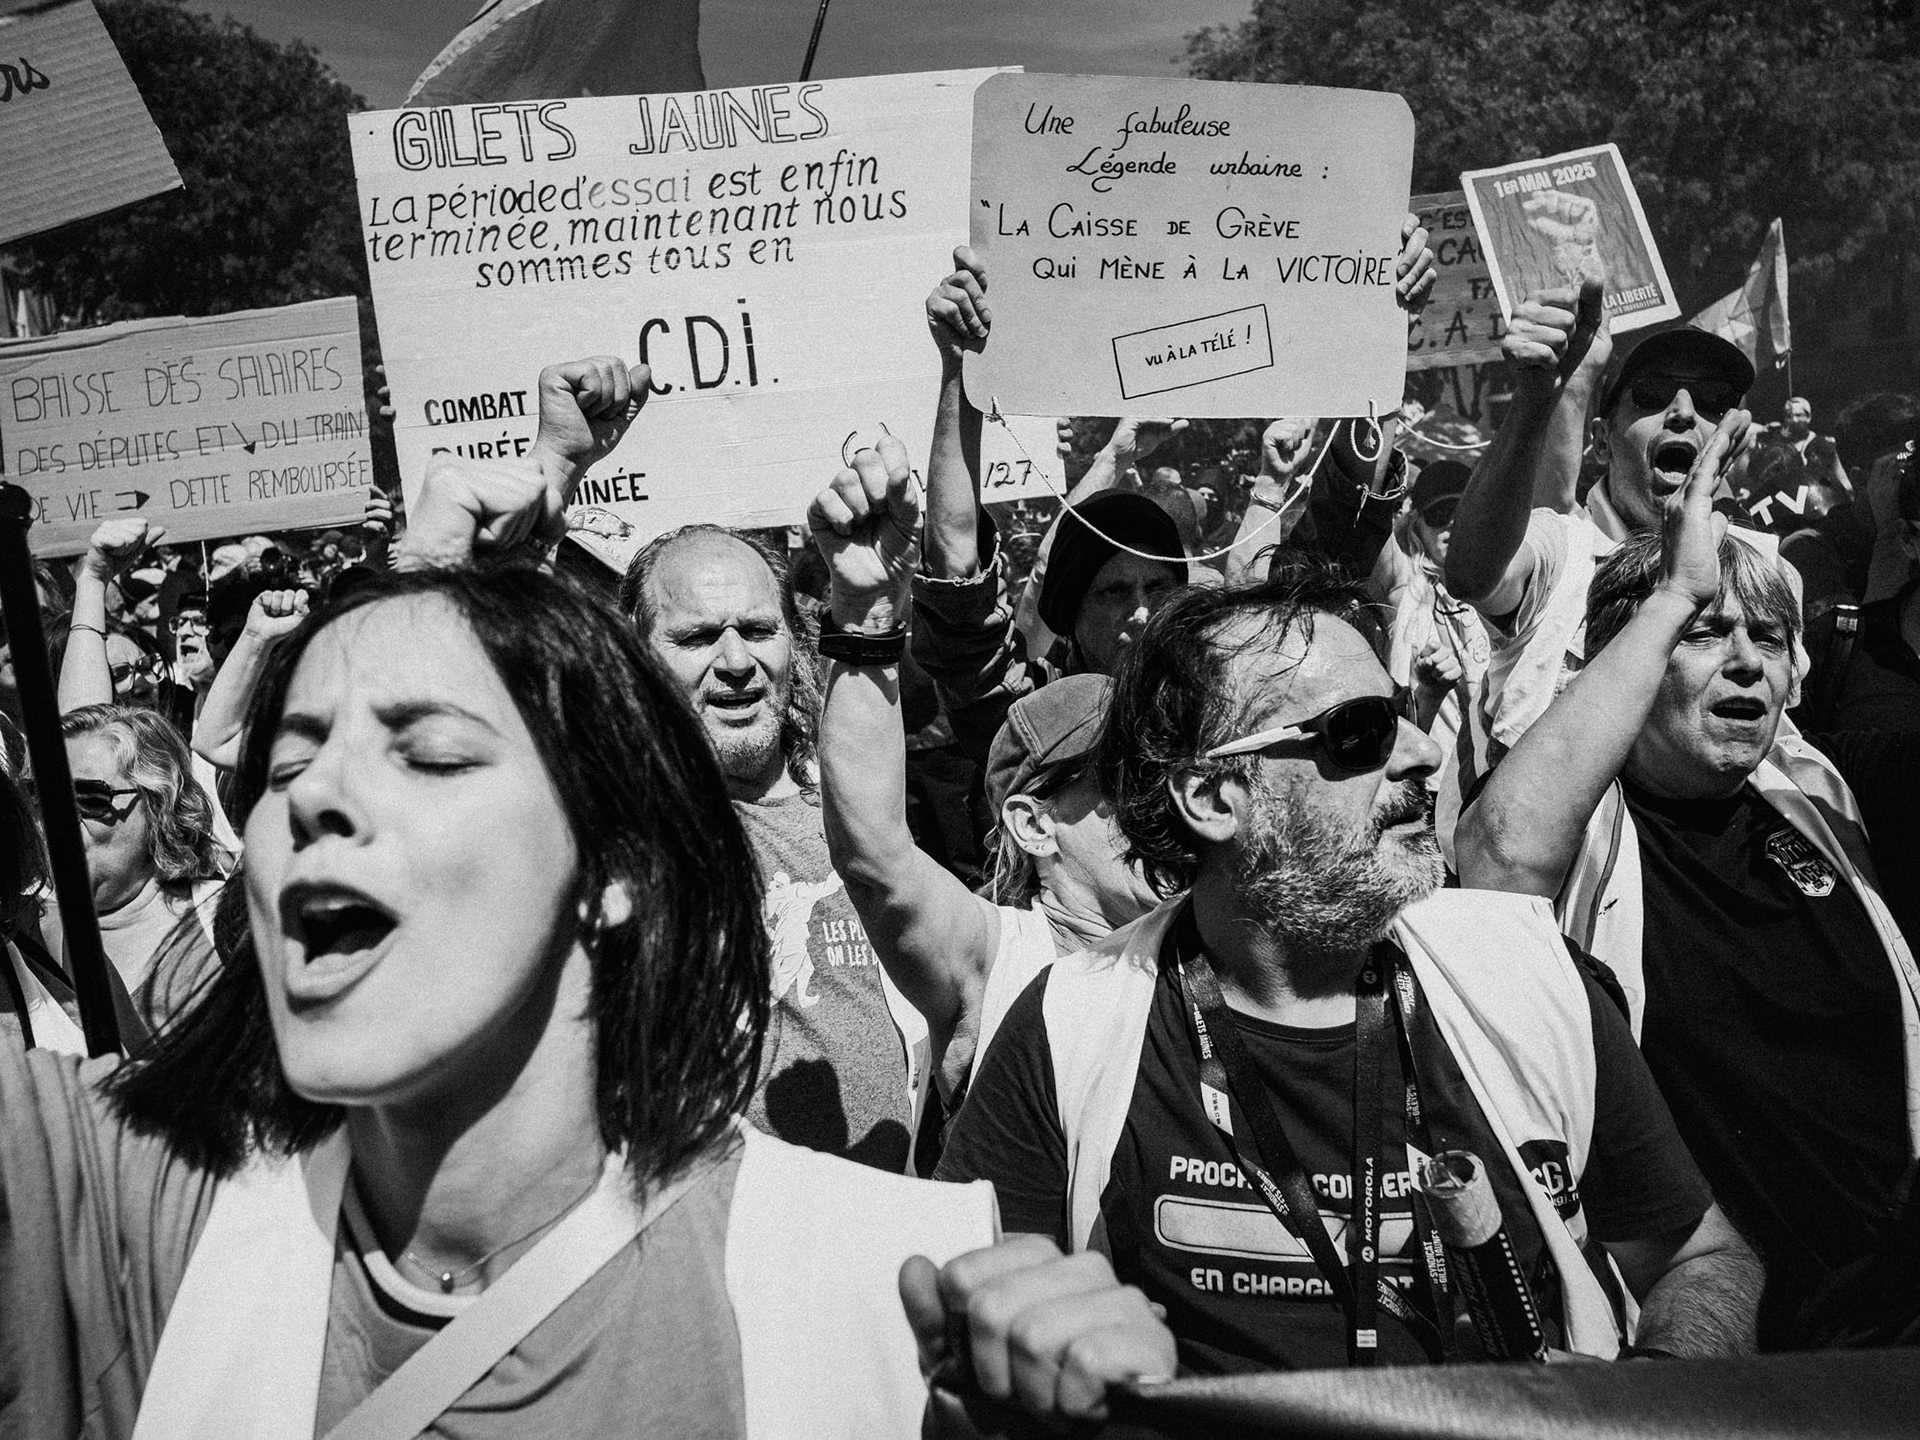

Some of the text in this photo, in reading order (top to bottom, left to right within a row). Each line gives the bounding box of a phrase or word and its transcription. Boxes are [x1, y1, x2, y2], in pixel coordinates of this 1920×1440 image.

[393, 84, 829, 171] GILETS JAUNES
[1024, 102, 1231, 151] Une fabuleuse
[369, 196, 418, 226] La
[708, 163, 762, 199] est
[780, 149, 879, 199] enfin
[1066, 146, 1177, 193] Légende
[1209, 151, 1303, 178] urbaine
[1517, 171, 1553, 193] MAI
[1552, 161, 1597, 186] 2025
[369, 189, 908, 262] terminée, maintenant nous
[1048, 202, 1138, 239] CAISSE
[1167, 220, 1192, 236] DE
[1216, 206, 1301, 240] GRÈVE
[476, 235, 794, 288] sommes tous en
[1100, 255, 1166, 280] MÈNE
[1183, 255, 1198, 280] À
[1222, 256, 1250, 281] LA
[1602, 282, 1659, 309] LA LIBERTÉ
[1200, 328, 1237, 354] TÉLÉ
[11, 372, 121, 423] BAISSE
[218, 346, 343, 400] SALAIRES
[424, 390, 528, 426] COMBAT
[18, 444, 67, 476] DES
[196, 424, 228, 455] ET
[261, 418, 298, 449] DU
[305, 405, 363, 443] TRAIN
[66, 485, 102, 522] VIE
[169, 474, 231, 509] DETTE
[248, 451, 371, 499] REMBOURSÉE
[1750, 485, 1809, 526] TV
[822, 919, 847, 943] LES
[827, 944, 845, 967] ON
[847, 944, 869, 967] LES
[1259, 1183, 1286, 1216] SYNDICAT
[1365, 1157, 1374, 1242] MOTOROLA
[1423, 1241, 1438, 1279] SYNDICAT
[1436, 1257, 1448, 1285] GILETS
[1191, 1267, 1224, 1293] EN
